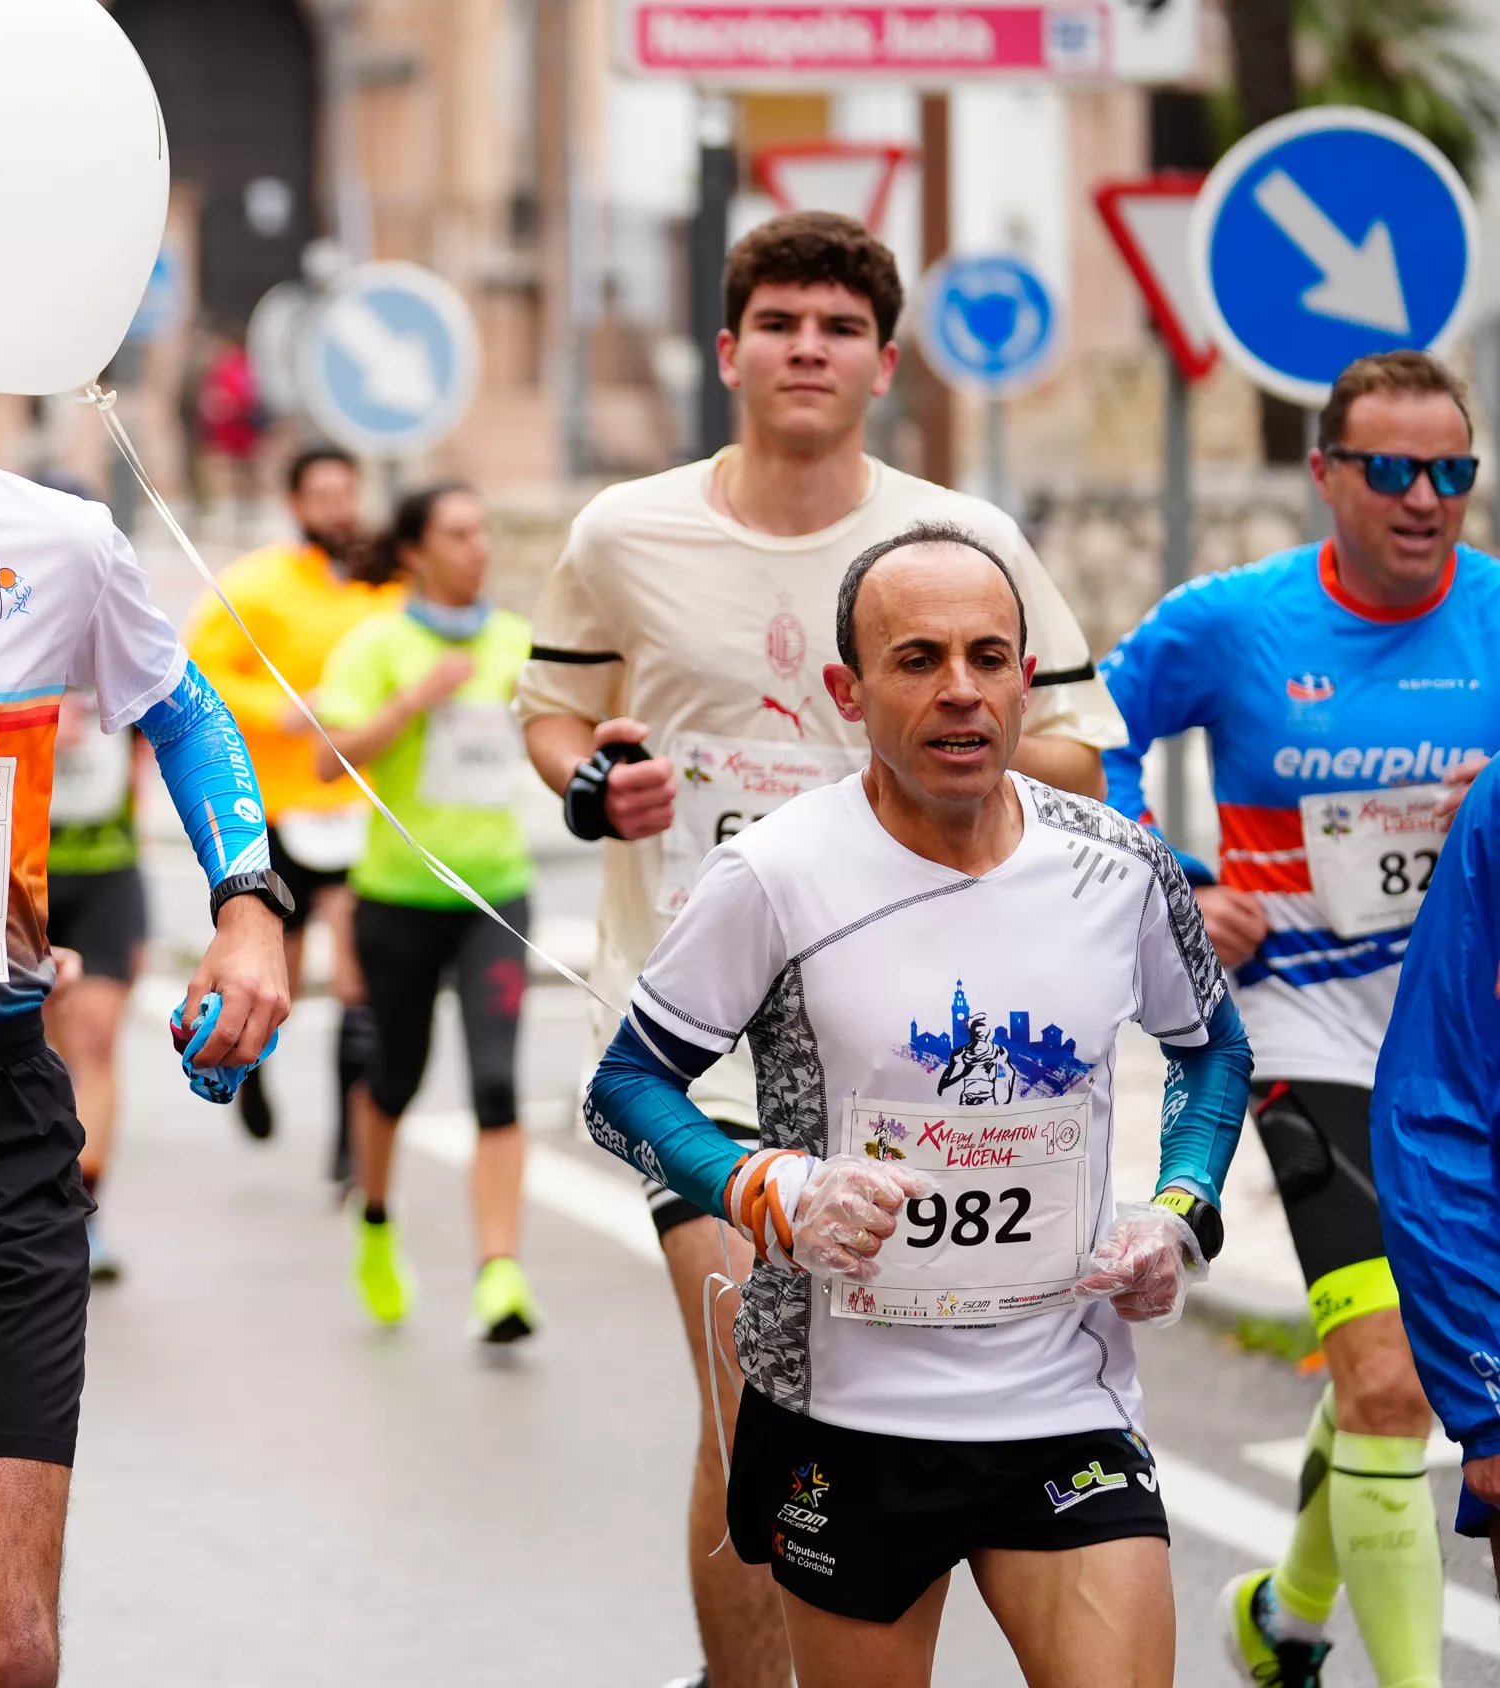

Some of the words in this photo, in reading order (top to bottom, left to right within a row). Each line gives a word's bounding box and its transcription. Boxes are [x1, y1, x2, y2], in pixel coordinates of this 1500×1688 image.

[586, 1120, 629, 1159] ODUCT
[594, 1111, 627, 1148] PART
[980, 1125, 1038, 1144] MARATÓN
[946, 1145, 1022, 1168] LUCENA
[906, 1187, 1032, 1248] 982
[999, 1288, 1071, 1304] mediamaratonlucena.com
[777, 1509, 819, 1533] Lucena
[786, 1553, 795, 1563] de
[797, 1556, 834, 1576] Córdoba
[787, 1540, 836, 1565] Diputación
